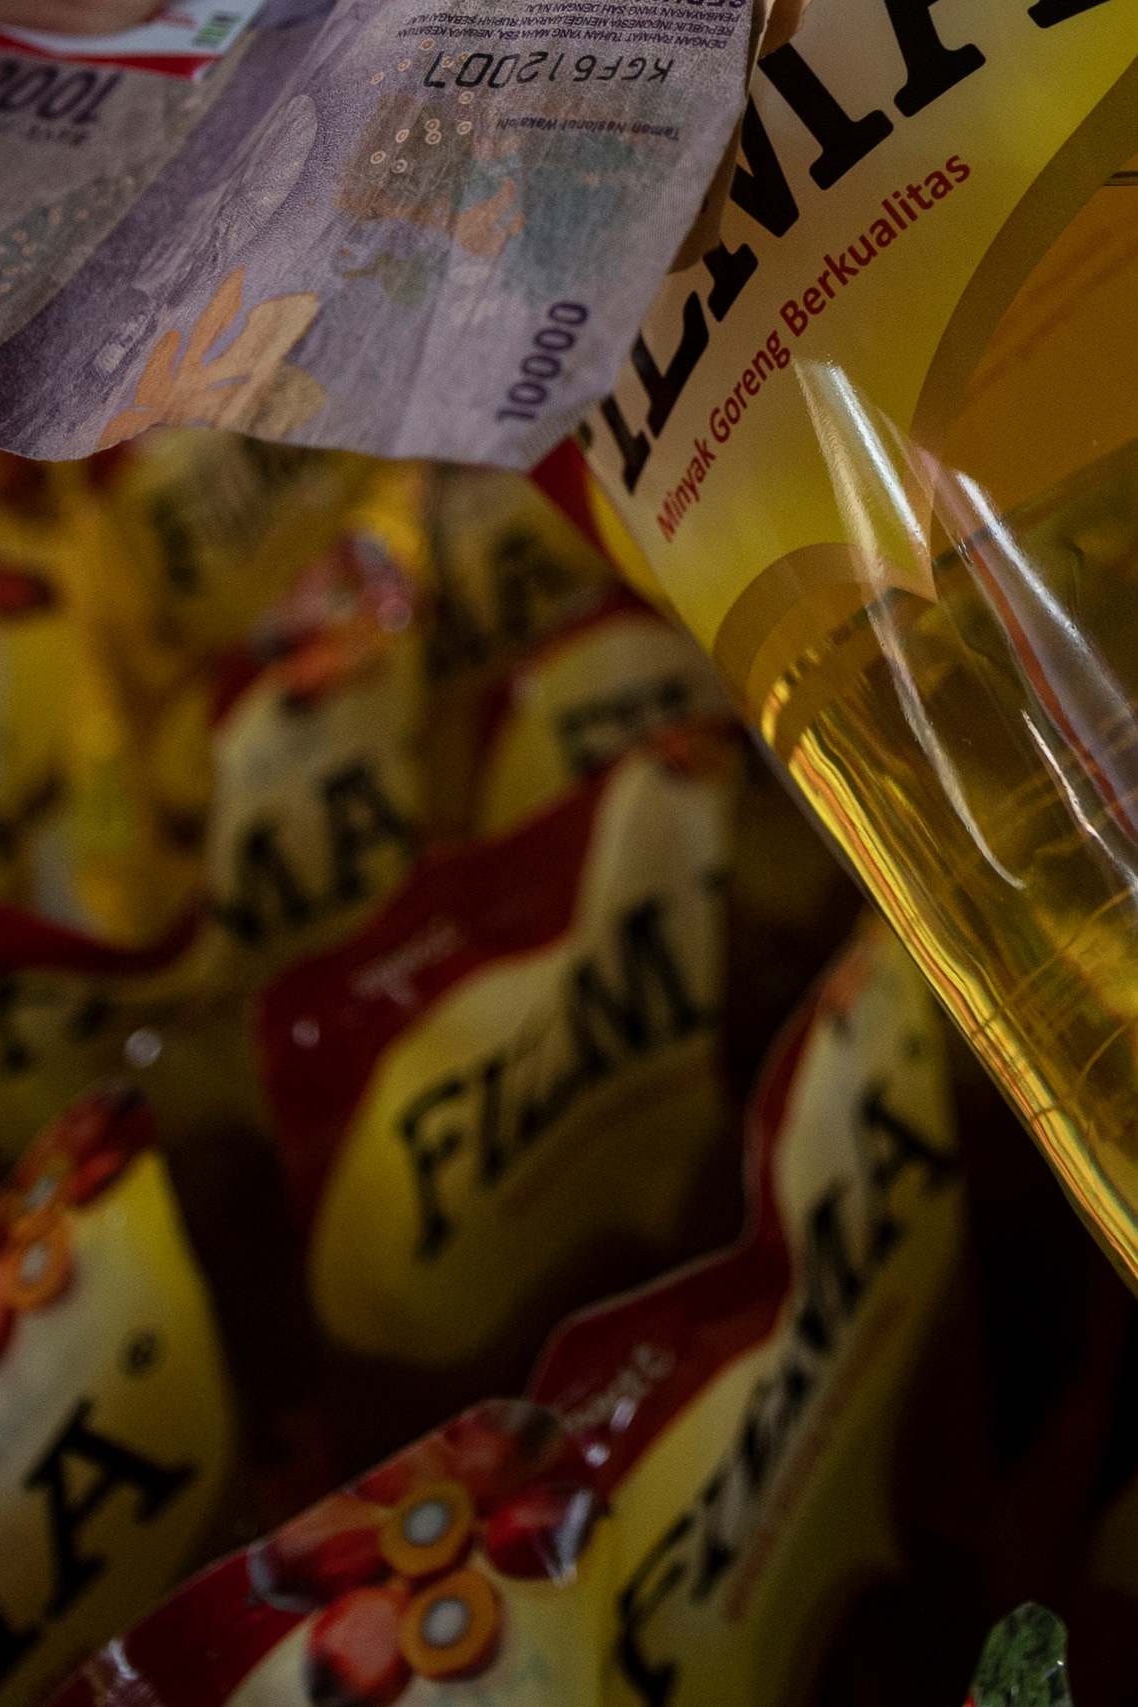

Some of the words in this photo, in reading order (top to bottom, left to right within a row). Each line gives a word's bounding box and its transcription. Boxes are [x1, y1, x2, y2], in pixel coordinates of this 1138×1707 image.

[552, 3, 600, 14] DENGAN
[600, 4, 626, 15] SAH
[628, 6, 659, 16] YANG
[661, 6, 740, 22] PEMBAYARAN
[610, 18, 671, 30] INDONESIA
[672, 22, 734, 36] REPUBLIK
[448, 27, 493, 38] NEGARA
[551, 28, 582, 39] YANG
[584, 30, 623, 42] TUHAN
[625, 32, 673, 44] RAHMAT
[674, 35, 727, 49] DENGAN
[422, 50, 675, 89] KGF612007
[631, 122, 679, 141] Taman
[656, 438, 716, 543] Minyak
[709, 330, 791, 444] Goreng
[779, 154, 972, 338] Berkualitas
[497, 300, 590, 426] 10000
